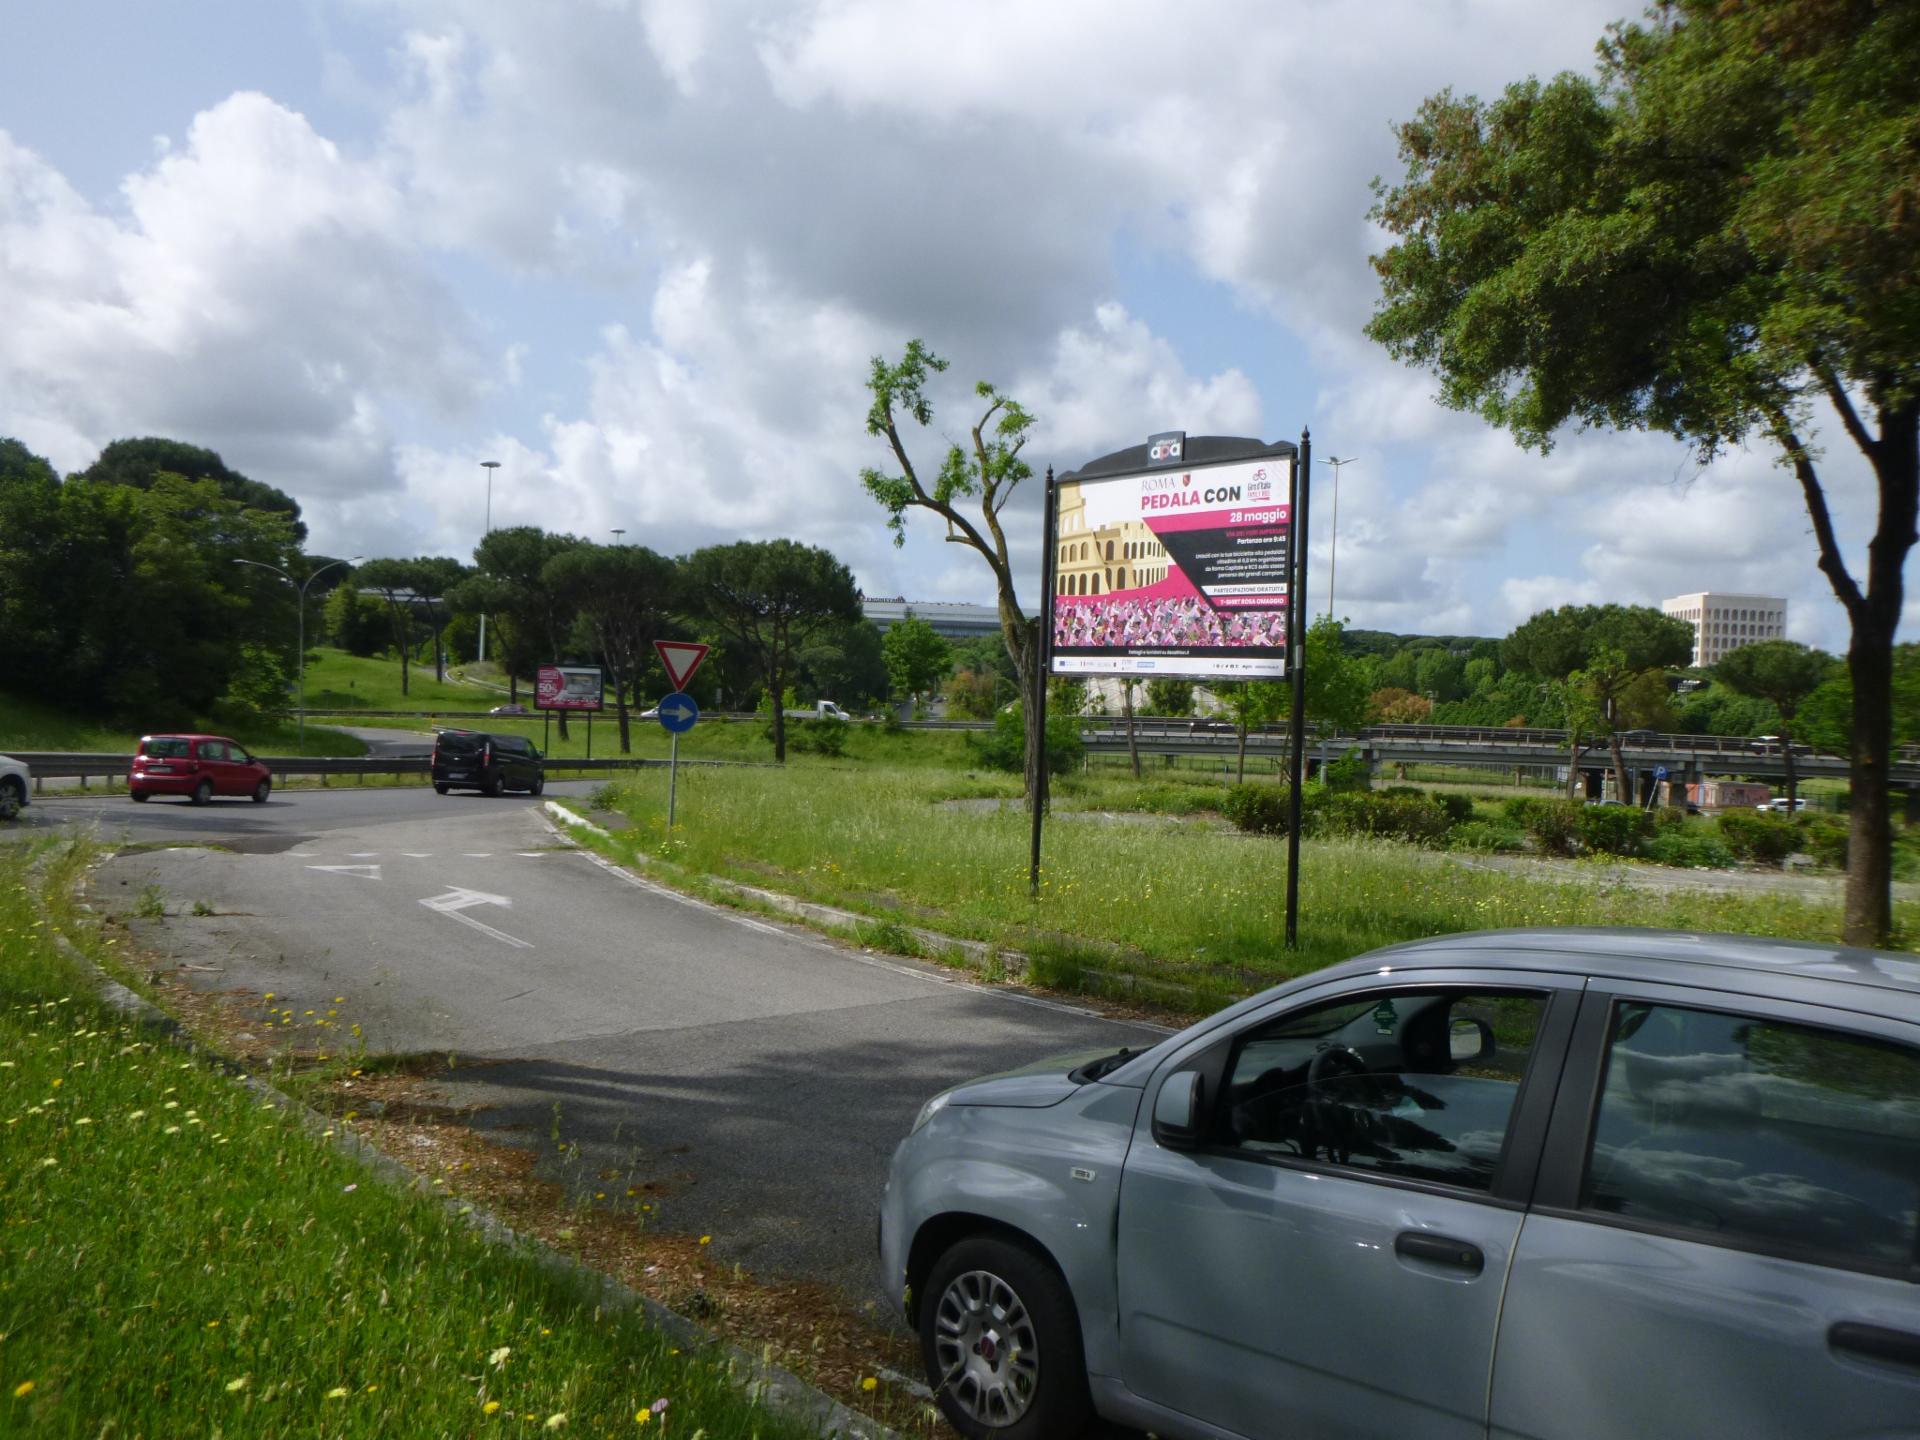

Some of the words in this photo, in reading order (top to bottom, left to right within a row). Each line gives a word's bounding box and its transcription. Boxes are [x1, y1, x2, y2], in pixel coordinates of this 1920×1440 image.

[1141, 477, 1176, 491] ROMA
[1141, 490, 1201, 510] PEDALA
[1204, 486, 1241, 504] CON
[1229, 512, 1242, 523] 28
[1244, 508, 1287, 523] maggio
[1237, 537, 1262, 545] Partenza
